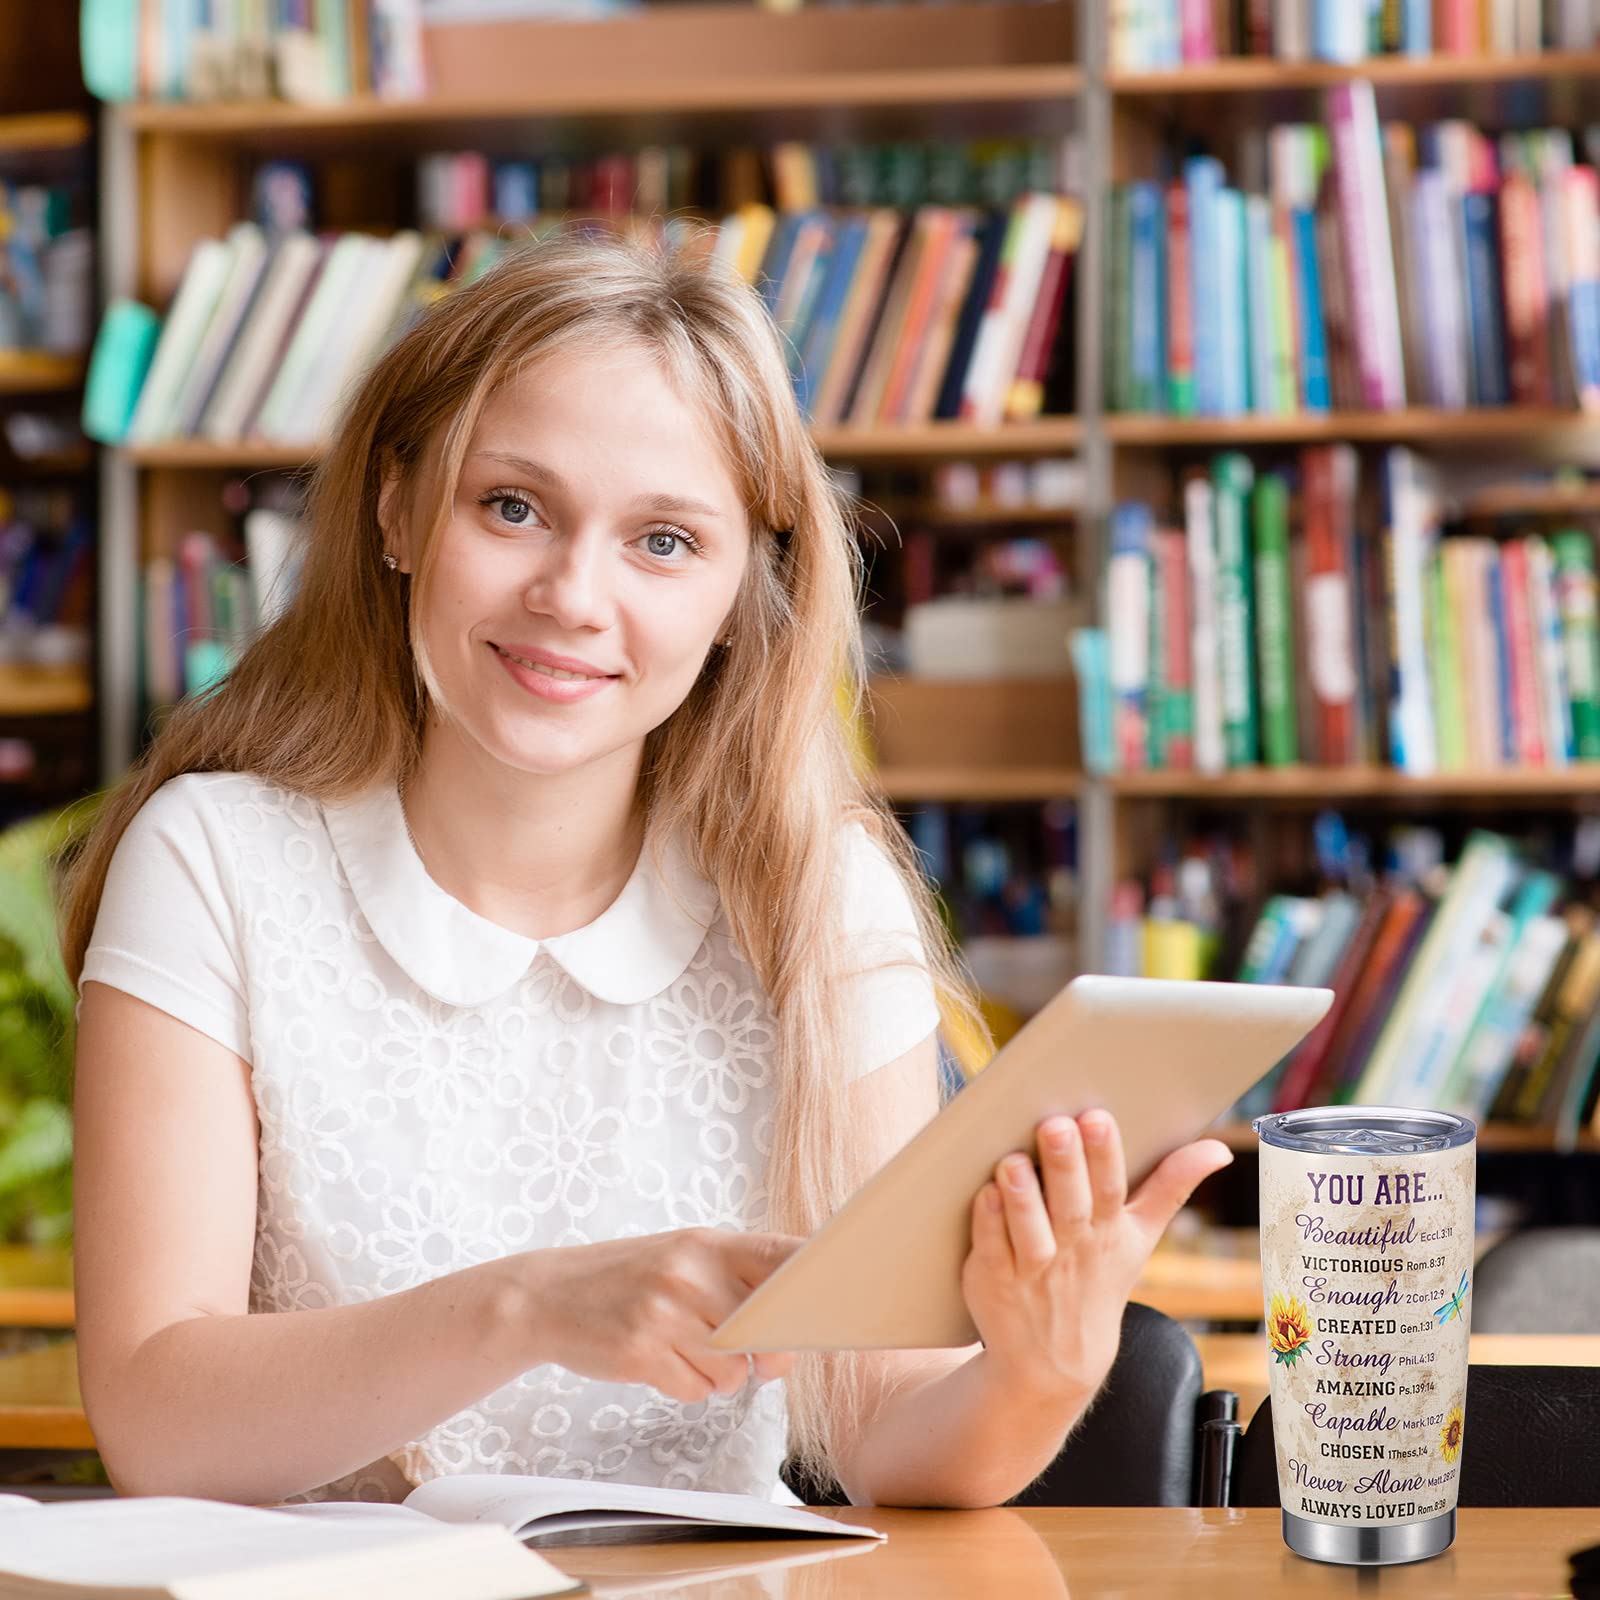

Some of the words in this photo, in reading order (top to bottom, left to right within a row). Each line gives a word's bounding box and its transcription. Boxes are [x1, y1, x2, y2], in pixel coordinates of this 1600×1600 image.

[1307, 1172, 1364, 1205] YOU
[1374, 1172, 1443, 1205] ARE...
[1295, 1214, 1418, 1253] Beautiful
[1421, 1228, 1453, 1241] Eccl.3:11
[1302, 1256, 1403, 1273] VICTORIOUS
[1407, 1257, 1446, 1270] Rom.8:37
[1302, 1276, 1403, 1314] Enough
[1406, 1289, 1444, 1304] 2Cor.12:9
[1318, 1318, 1396, 1334] CREATED
[1400, 1320, 1433, 1334] Gen.1:31
[1316, 1340, 1396, 1375] Strong
[1399, 1353, 1435, 1366] Phil.4:13
[1316, 1380, 1395, 1396] AMAZING
[1305, 1402, 1400, 1438] Capable
[1403, 1414, 1444, 1430] Mark.10:27
[1321, 1443, 1384, 1459] CHOSEN
[1289, 1458, 1347, 1493] Never
[1354, 1469, 1426, 1494] Alone
[1301, 1497, 1361, 1519] ALWAYS
[1367, 1503, 1415, 1519] LOVED
